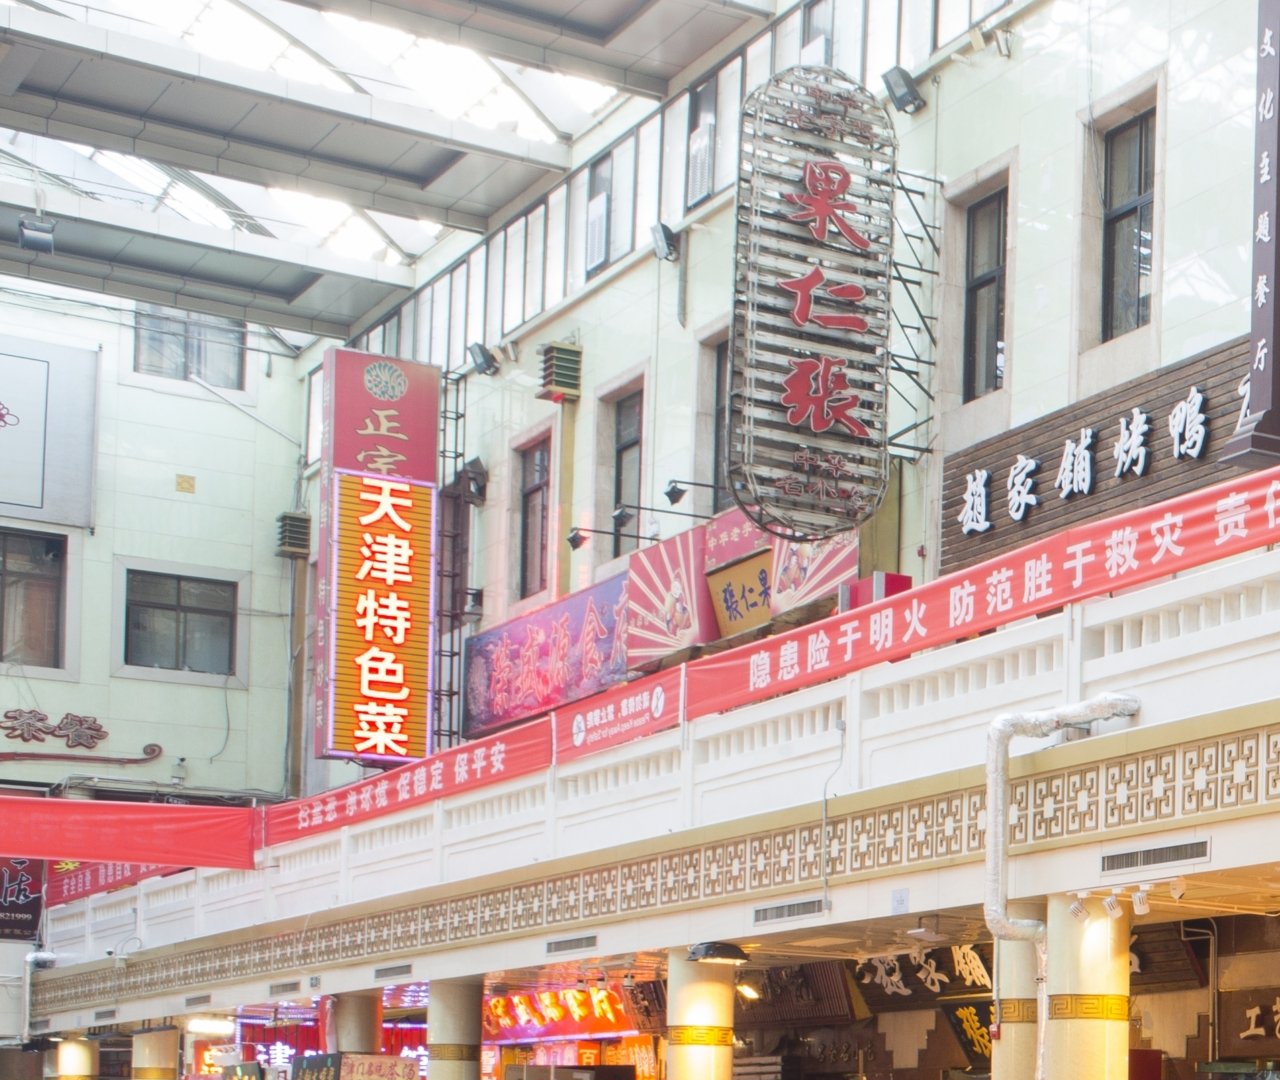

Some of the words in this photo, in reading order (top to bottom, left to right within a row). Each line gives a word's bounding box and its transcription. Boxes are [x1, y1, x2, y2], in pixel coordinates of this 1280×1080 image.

[354, 478, 413, 755] 天津特色菜
[750, 597, 927, 692] 隐患险于明火
[948, 513, 1185, 628] 防范胜于救灾
[455, 742, 506, 784] 保平安
